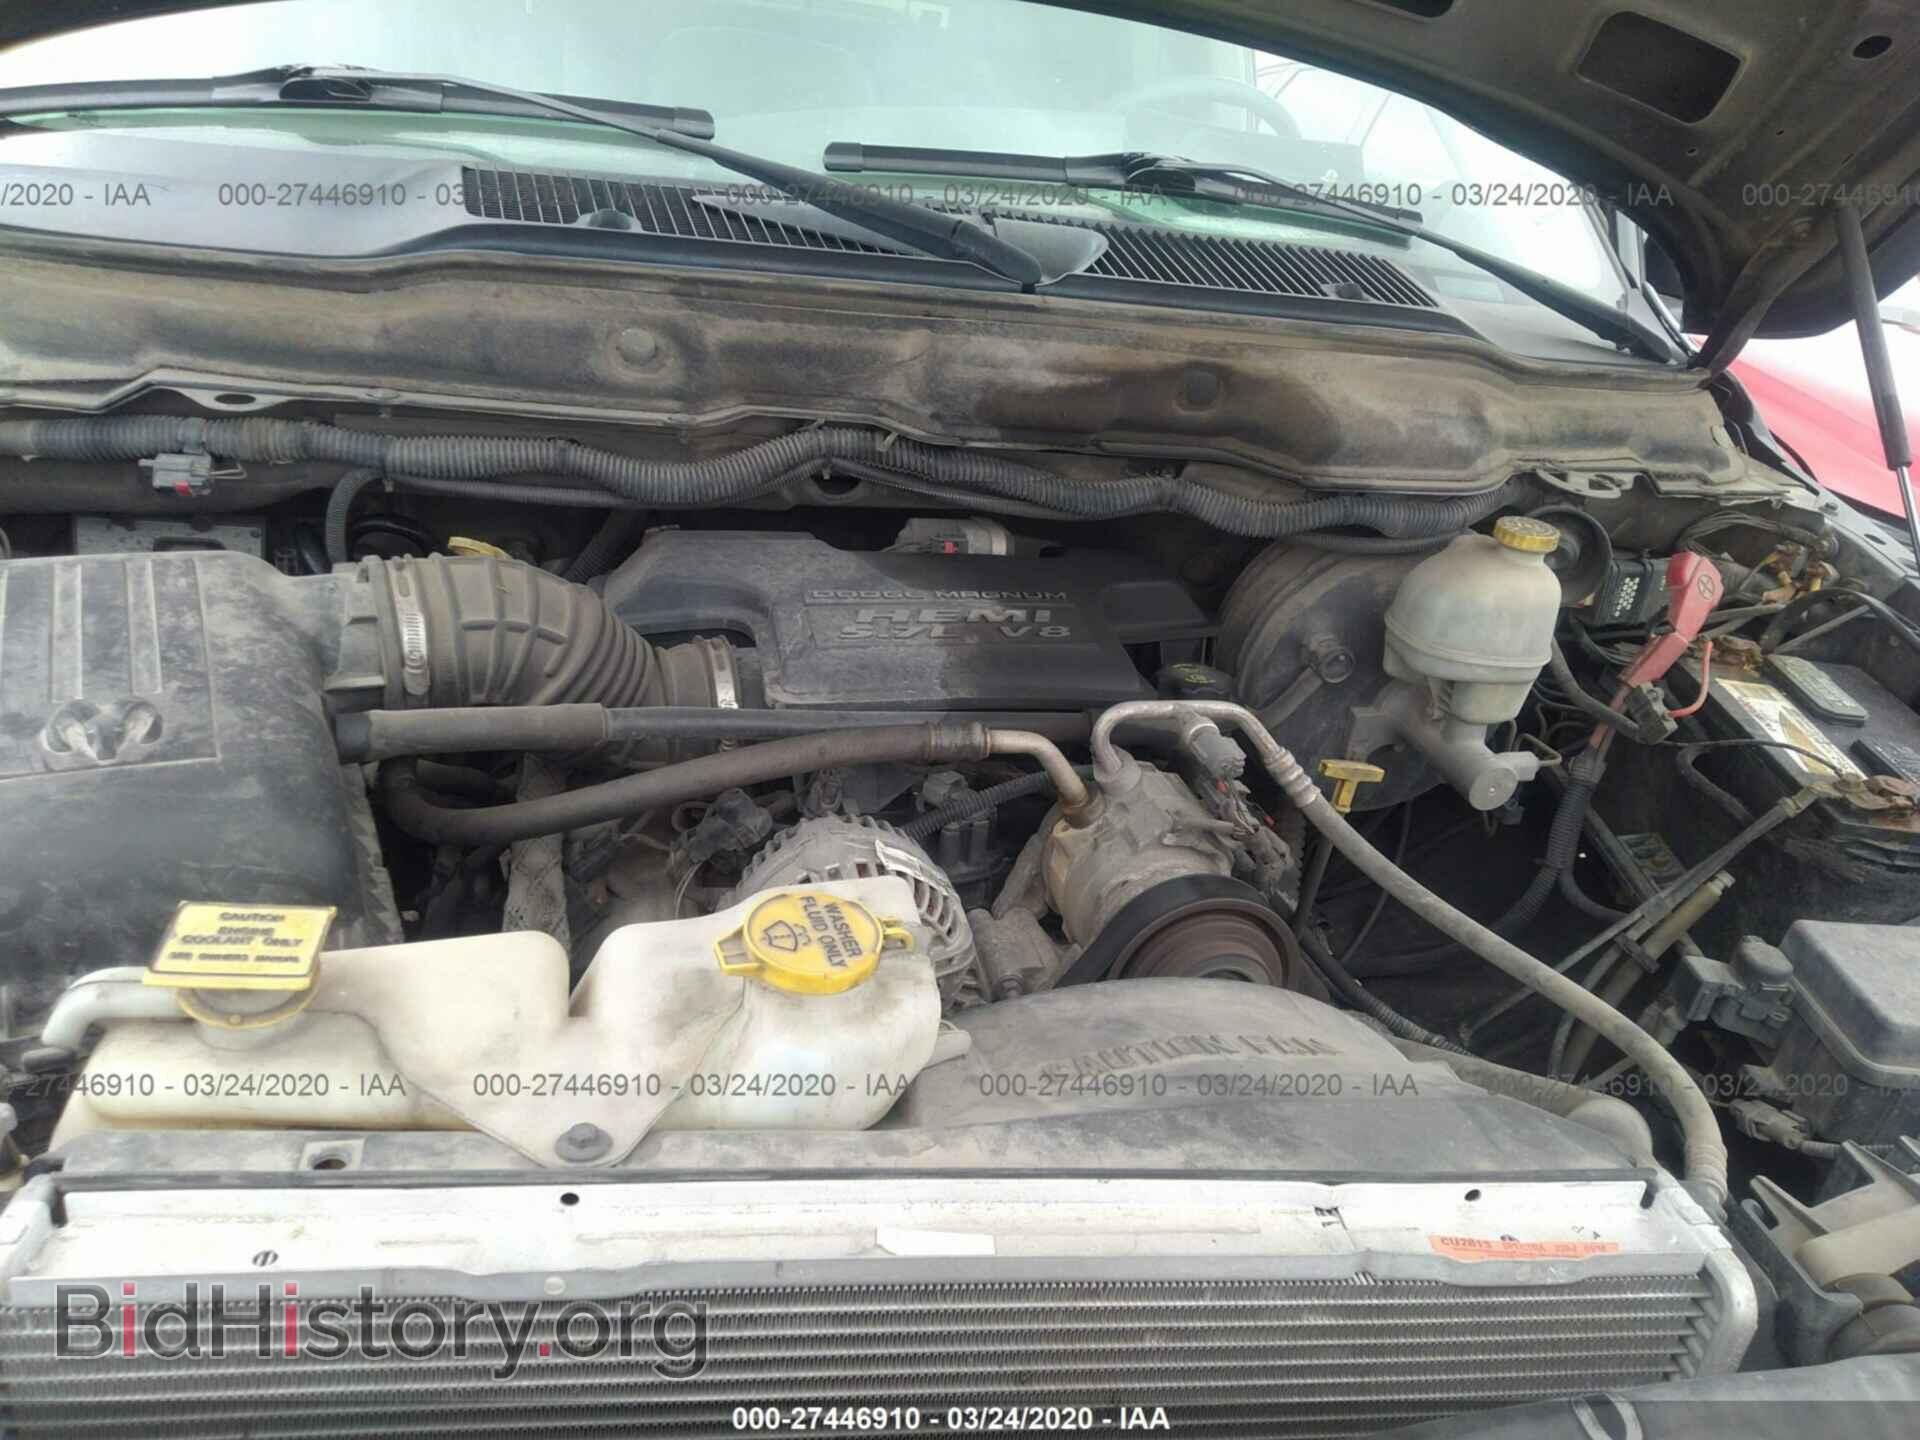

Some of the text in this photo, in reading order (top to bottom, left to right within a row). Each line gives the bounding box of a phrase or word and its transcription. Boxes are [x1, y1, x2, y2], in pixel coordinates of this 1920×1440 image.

[935, 591, 1067, 600] MAGNUM
[855, 609, 1051, 623] HEMI
[1000, 626, 1072, 638] V8
[219, 912, 286, 922] CAUTION
[800, 895, 847, 968] FLUID ONLY
[824, 901, 863, 957] WASHER
[181, 934, 304, 947] COOLANT ONLY
